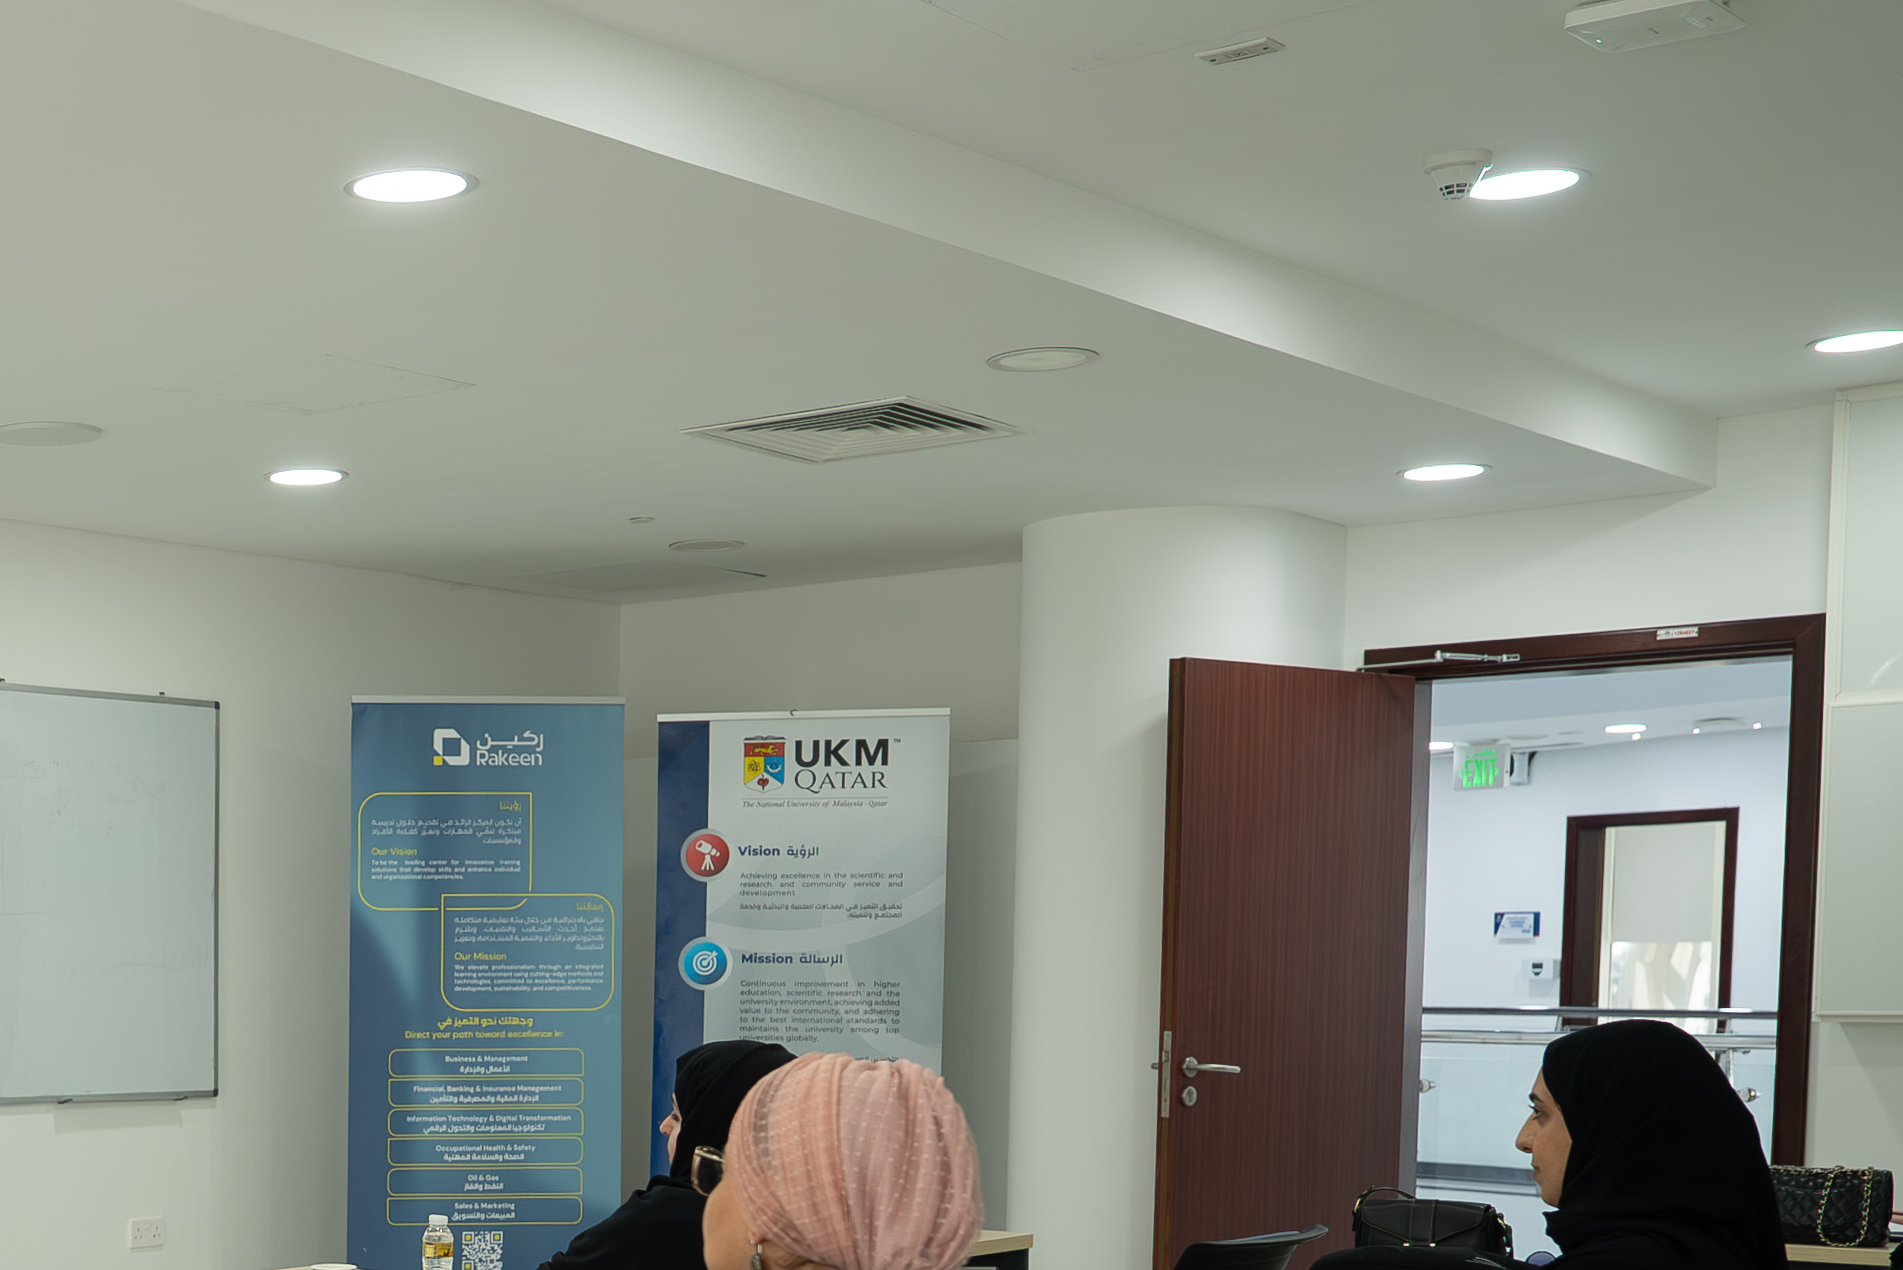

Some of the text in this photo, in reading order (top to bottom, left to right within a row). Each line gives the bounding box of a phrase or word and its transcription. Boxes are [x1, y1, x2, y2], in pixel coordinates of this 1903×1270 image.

[476, 730, 544, 752] ركين
[794, 738, 889, 768] UKM
[476, 750, 543, 766] Rakeen
[1463, 758, 1497, 788] EXIT
[794, 769, 888, 794] QATAR
[786, 800, 820, 809] University
[832, 800, 863, 809] Malaysia
[371, 848, 417, 856] Our Vision
[738, 844, 819, 859] Vision الرؤية
[740, 872, 778, 881] Achieving
[740, 880, 903, 889] research and community service and
[739, 889, 795, 898] development
[454, 952, 507, 960] Our Mission
[741, 952, 843, 967] Mission الرسالة
[794, 980, 848, 989] improvement
[873, 980, 900, 989] higher
[740, 989, 782, 998] education,
[740, 998, 900, 1007] university environment, achieving added
[792, 1008, 842, 1017] community,
[863, 1008, 900, 1017] adhering
[437, 1016, 533, 1030] وجهتك نحو التميز في
[452, 1031, 474, 1039] path
[805, 1026, 844, 1035] university
[850, 1027, 879, 1035] among
[885, 1026, 900, 1035] top
[786, 1034, 818, 1044] globally.
[485, 1065, 511, 1074] الأعمال
[446, 1085, 474, 1093] Banking
[517, 1085, 562, 1093] Management
[448, 1114, 488, 1123] Technology
[495, 1114, 518, 1123] Digital
[435, 1144, 482, 1153] Occupational
[513, 1144, 536, 1153] Safety
[480, 1202, 515, 1211] Marketing
